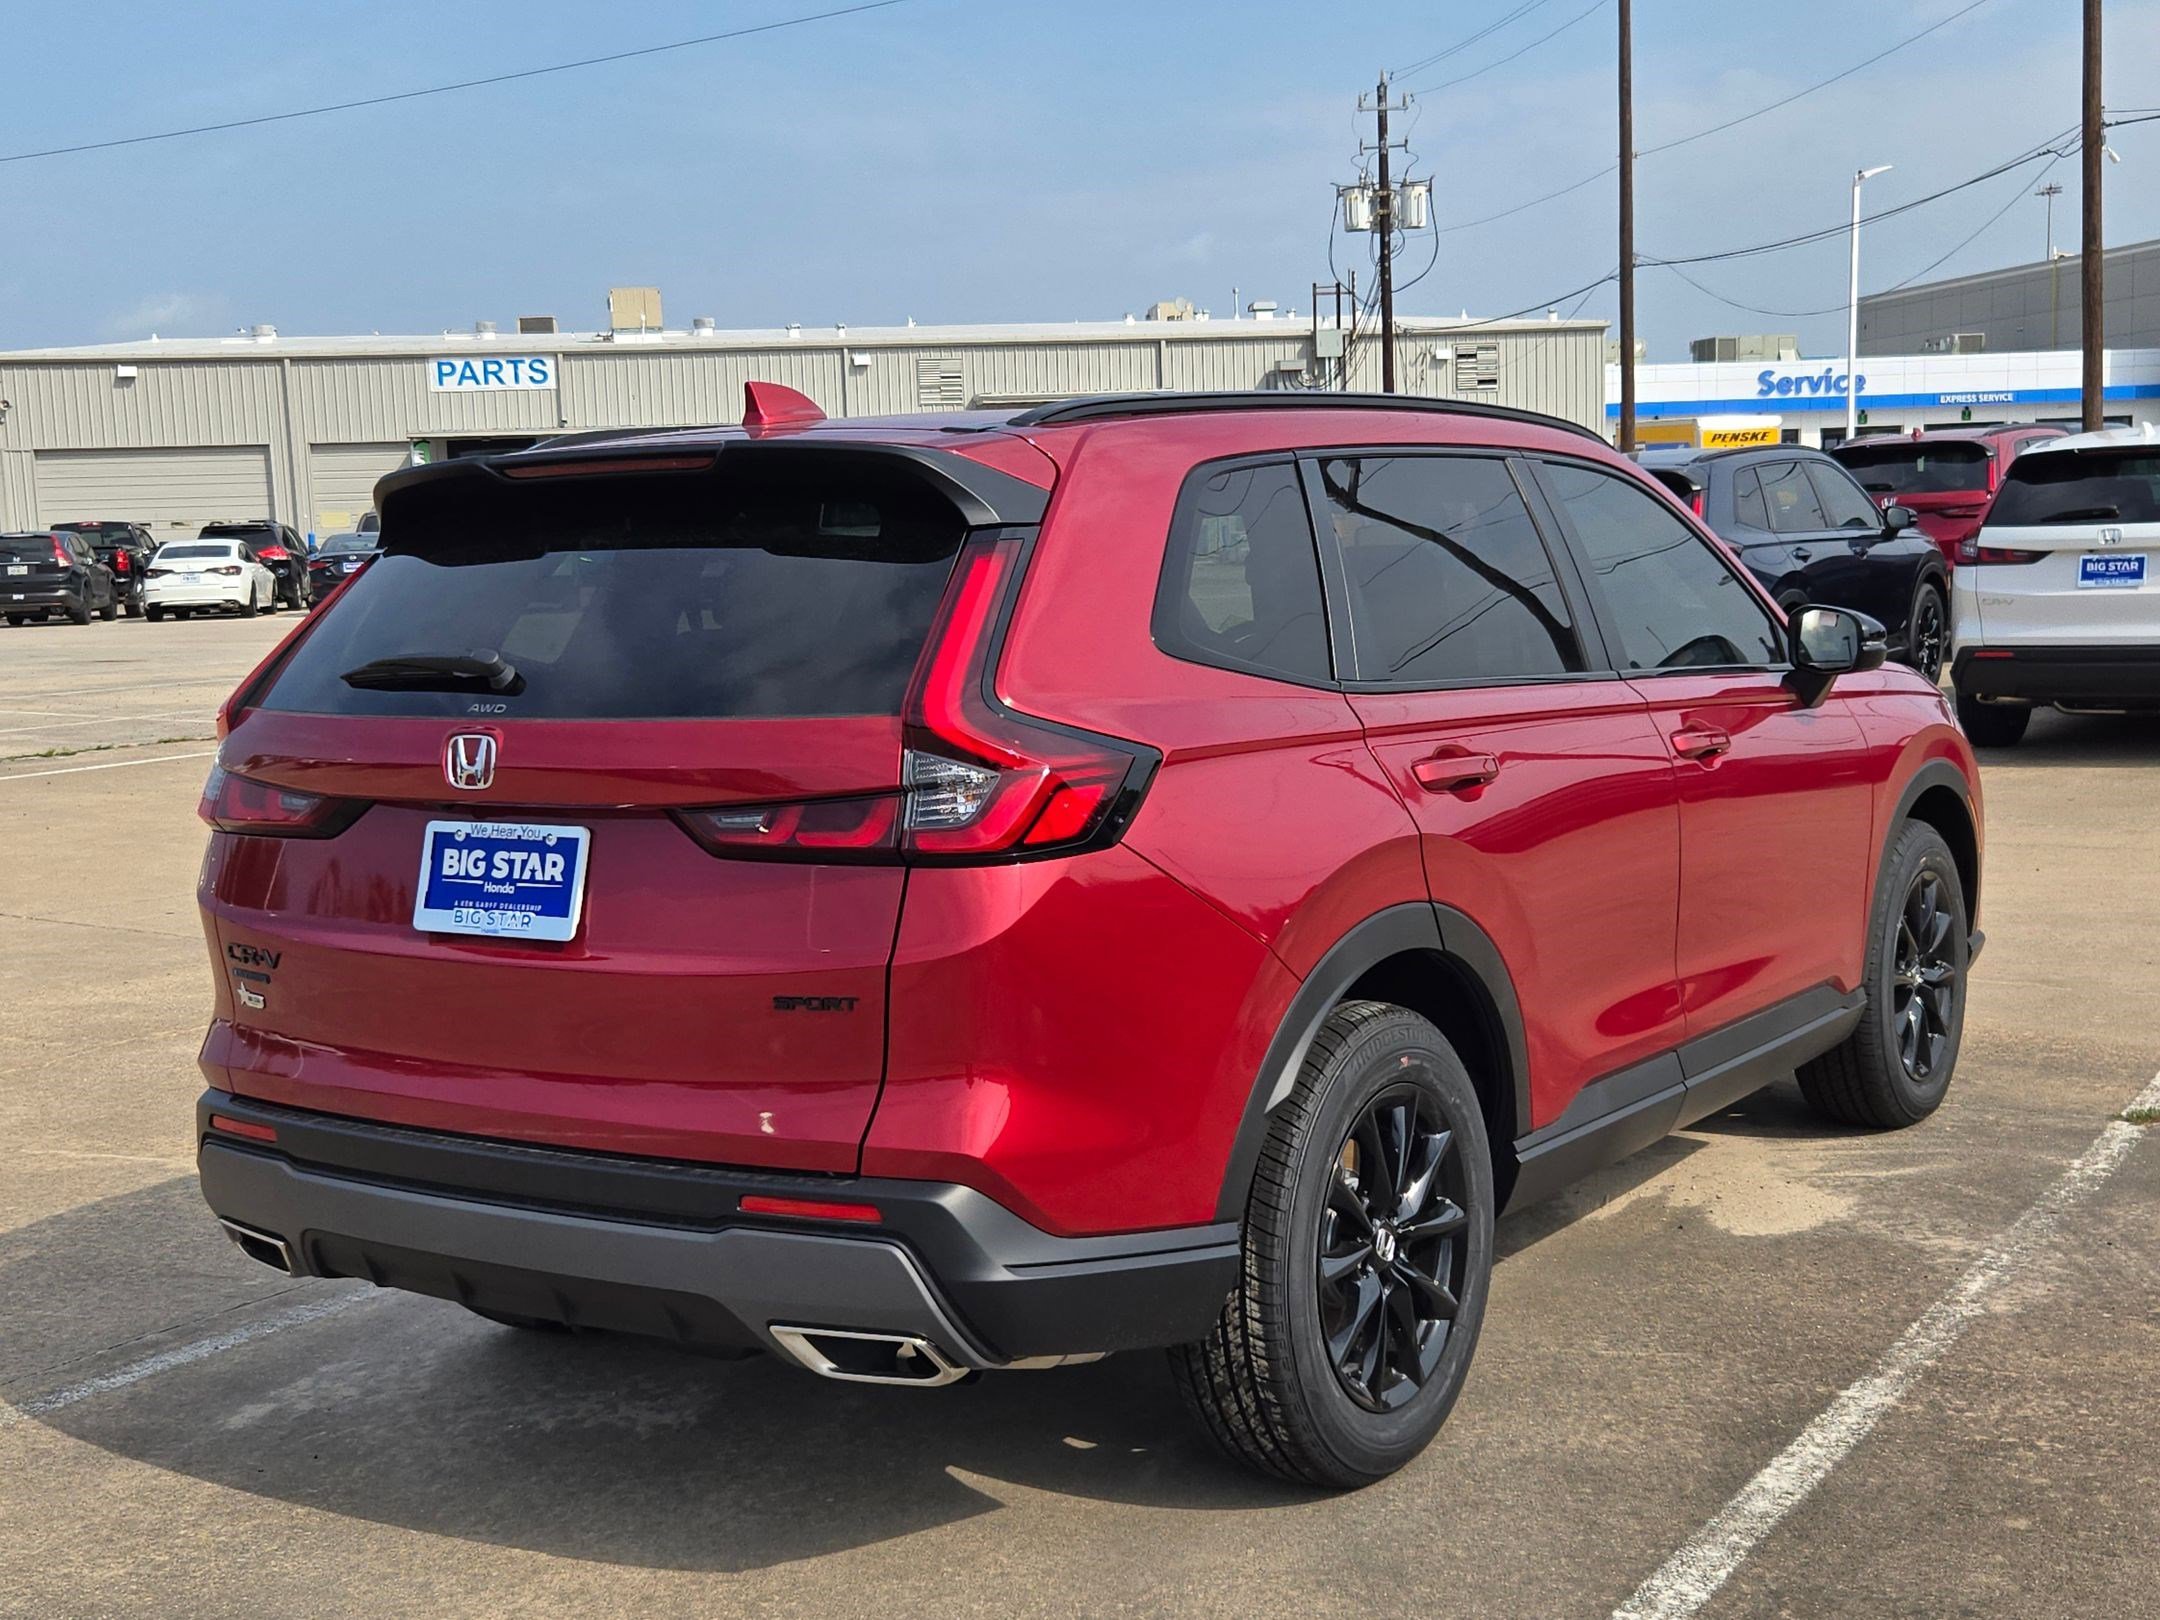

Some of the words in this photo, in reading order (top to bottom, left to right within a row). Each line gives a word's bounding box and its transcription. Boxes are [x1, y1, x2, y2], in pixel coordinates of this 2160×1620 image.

[437, 358, 549, 387] PARTS
[1757, 367, 1867, 396] Service
[1940, 394, 1978, 404] EXPRESS
[1979, 392, 2014, 402] SERVICE
[1711, 431, 1770, 443] PENSKE
[2086, 562, 2106, 571] BIG
[2108, 561, 2139, 571] STAR
[467, 703, 508, 713] AWD
[470, 823, 489, 836] We
[490, 824, 518, 837] Hear
[520, 825, 541, 839] You
[442, 848, 487, 878] BIG
[491, 850, 565, 882] STAR
[483, 881, 516, 894] Honda
[499, 902, 542, 912] DEALERSHIP
[454, 909, 482, 924] BIG
[486, 911, 532, 928] STAR
[773, 996, 860, 1011] SPORT
[1352, 1027, 1436, 1073] BRIDGESTON
